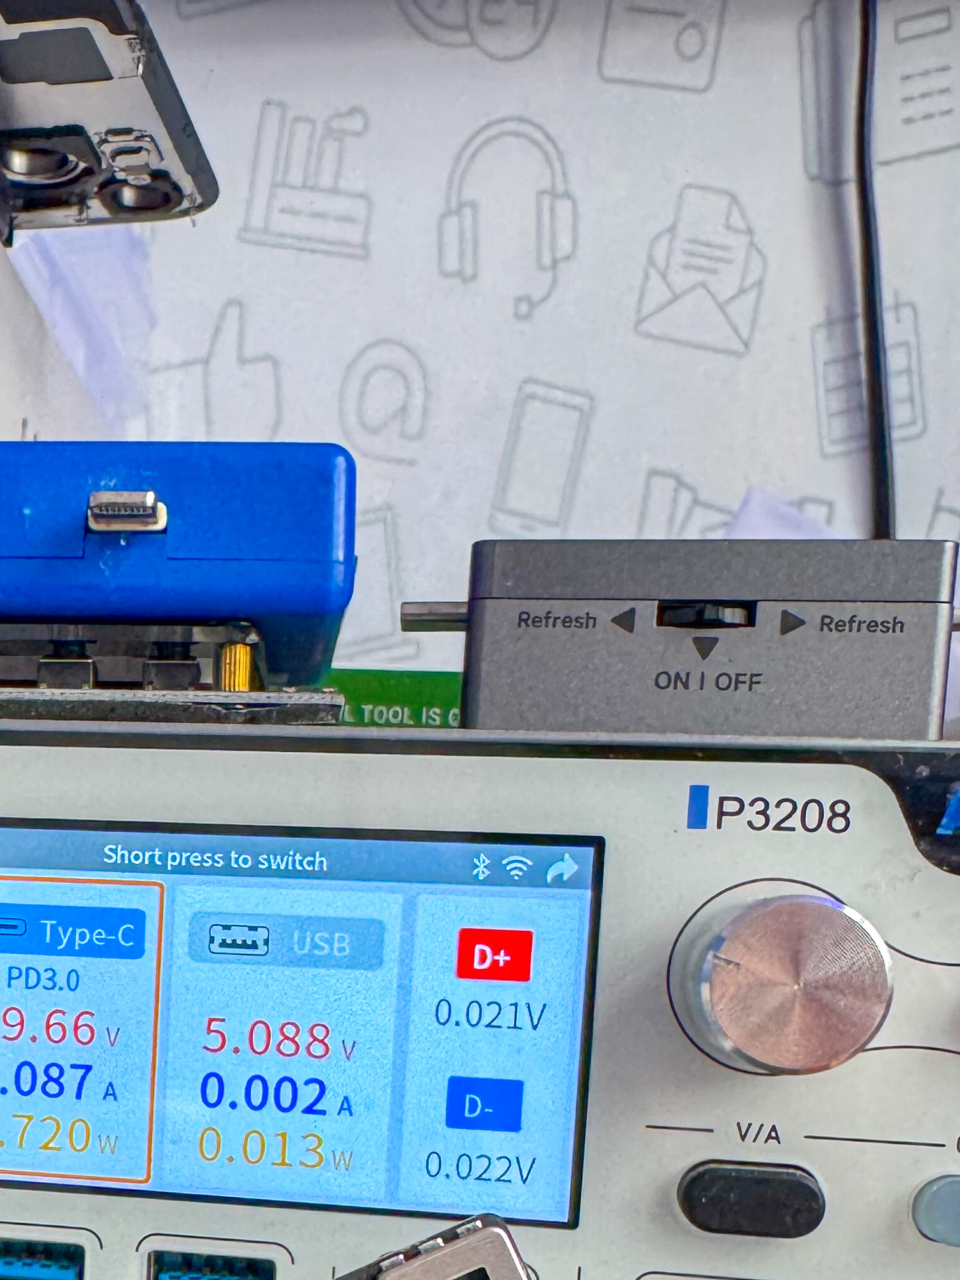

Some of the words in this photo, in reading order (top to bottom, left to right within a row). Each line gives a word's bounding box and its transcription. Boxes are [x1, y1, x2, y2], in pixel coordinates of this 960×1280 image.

[517, 610, 598, 630] Refresh
[819, 614, 905, 635] Refresh
[655, 671, 690, 692] ON
[715, 672, 762, 693] OFF
[361, 703, 415, 725] TOOL
[422, 706, 442, 726] IS
[715, 795, 851, 834] P3208
[103, 844, 162, 866] Short
[167, 851, 224, 870] press
[231, 850, 252, 869] to
[258, 850, 328, 872] switch
[40, 919, 135, 950] Type-C
[293, 929, 351, 957] USB
[473, 943, 511, 970] D+
[6, 965, 80, 992] PD3.0
[434, 998, 547, 1031] 0.021V
[106, 1026, 121, 1047] V
[202, 1017, 331, 1059] 5.088
[341, 1039, 356, 1061] V
[103, 1081, 118, 1102] A
[199, 1071, 327, 1116] 0.002
[337, 1095, 354, 1117] A
[464, 1094, 493, 1118] D-
[736, 1121, 782, 1145] V/A
[198, 1126, 326, 1169] 0.013
[425, 1151, 537, 1185] 0.022V
